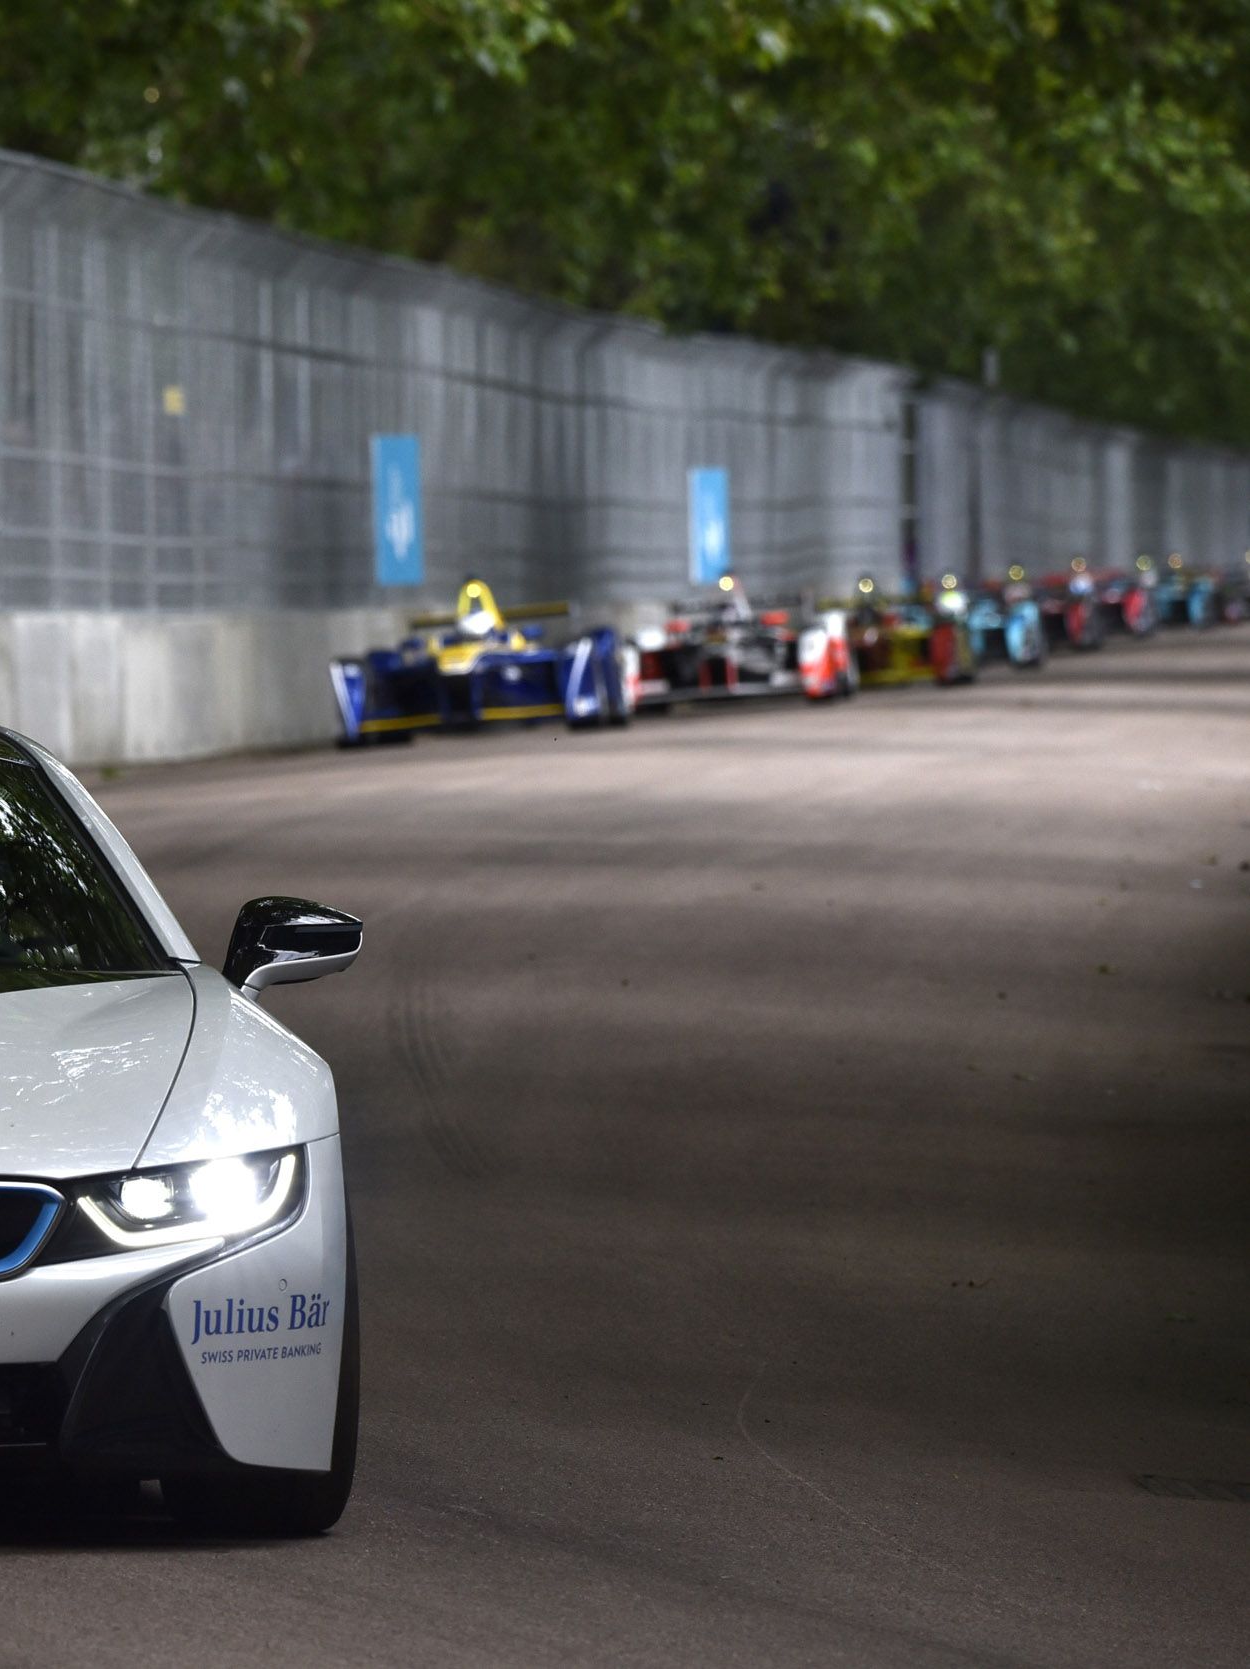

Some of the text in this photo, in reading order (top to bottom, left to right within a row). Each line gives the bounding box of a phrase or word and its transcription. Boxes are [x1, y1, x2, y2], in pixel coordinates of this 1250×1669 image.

[191, 1293, 330, 1345] Julius Bär
[201, 1342, 322, 1365] SWISS PRIVATE BANKING
